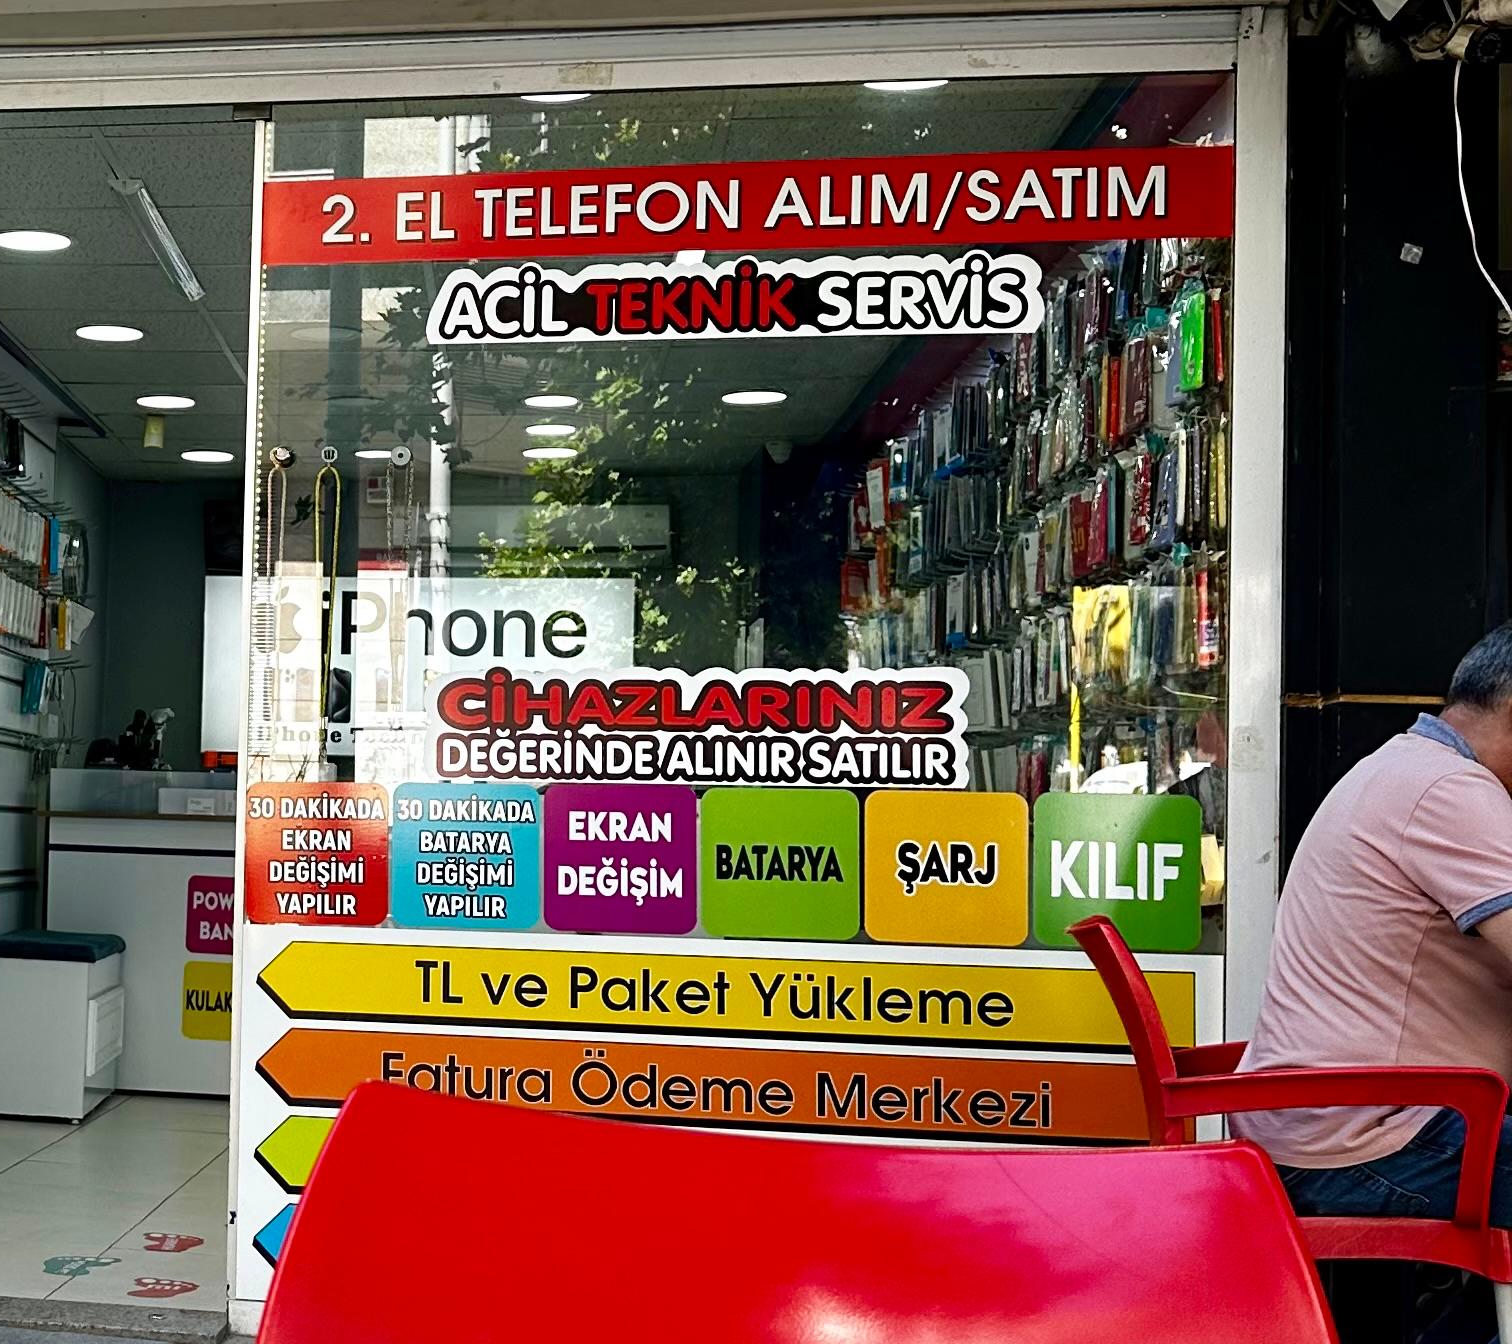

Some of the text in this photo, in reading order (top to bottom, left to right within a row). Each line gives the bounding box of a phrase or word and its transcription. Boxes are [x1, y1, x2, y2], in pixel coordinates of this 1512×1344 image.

[322, 164, 1170, 245] 2. EL TELEFON ALIM/SATIM
[439, 258, 1024, 338] ACİL TEKNİK SERVİS
[441, 672, 946, 727] CİHAZLARINIZ
[442, 729, 657, 776] DEĞERİNDE
[666, 740, 795, 777] ALINIR
[804, 742, 951, 779] SATILIR
[249, 792, 385, 822] 30 DAKİKADA
[397, 793, 535, 823] 30 DAKİKADA
[281, 829, 352, 852] EKRAN
[420, 830, 512, 855] BATARYA
[568, 810, 672, 843] EKRAN
[269, 856, 364, 889] DEĞİŞİMİ
[416, 856, 514, 890] DEĞİŞİMİ
[715, 844, 844, 883] BATARYA
[897, 840, 998, 896] ŞARJ
[1050, 840, 1184, 901] KILIF
[556, 859, 683, 907] DEĞİŞİM
[192, 892, 234, 911] POW
[275, 893, 356, 916] YAPILIR
[424, 894, 507, 919] YAPILIR
[199, 921, 234, 941] BAN
[185, 988, 233, 1013] KULAK
[415, 960, 1016, 1026] TL ve Paket Yükleme
[381, 1048, 1054, 1130] Fatura Ödeme Merkezi
